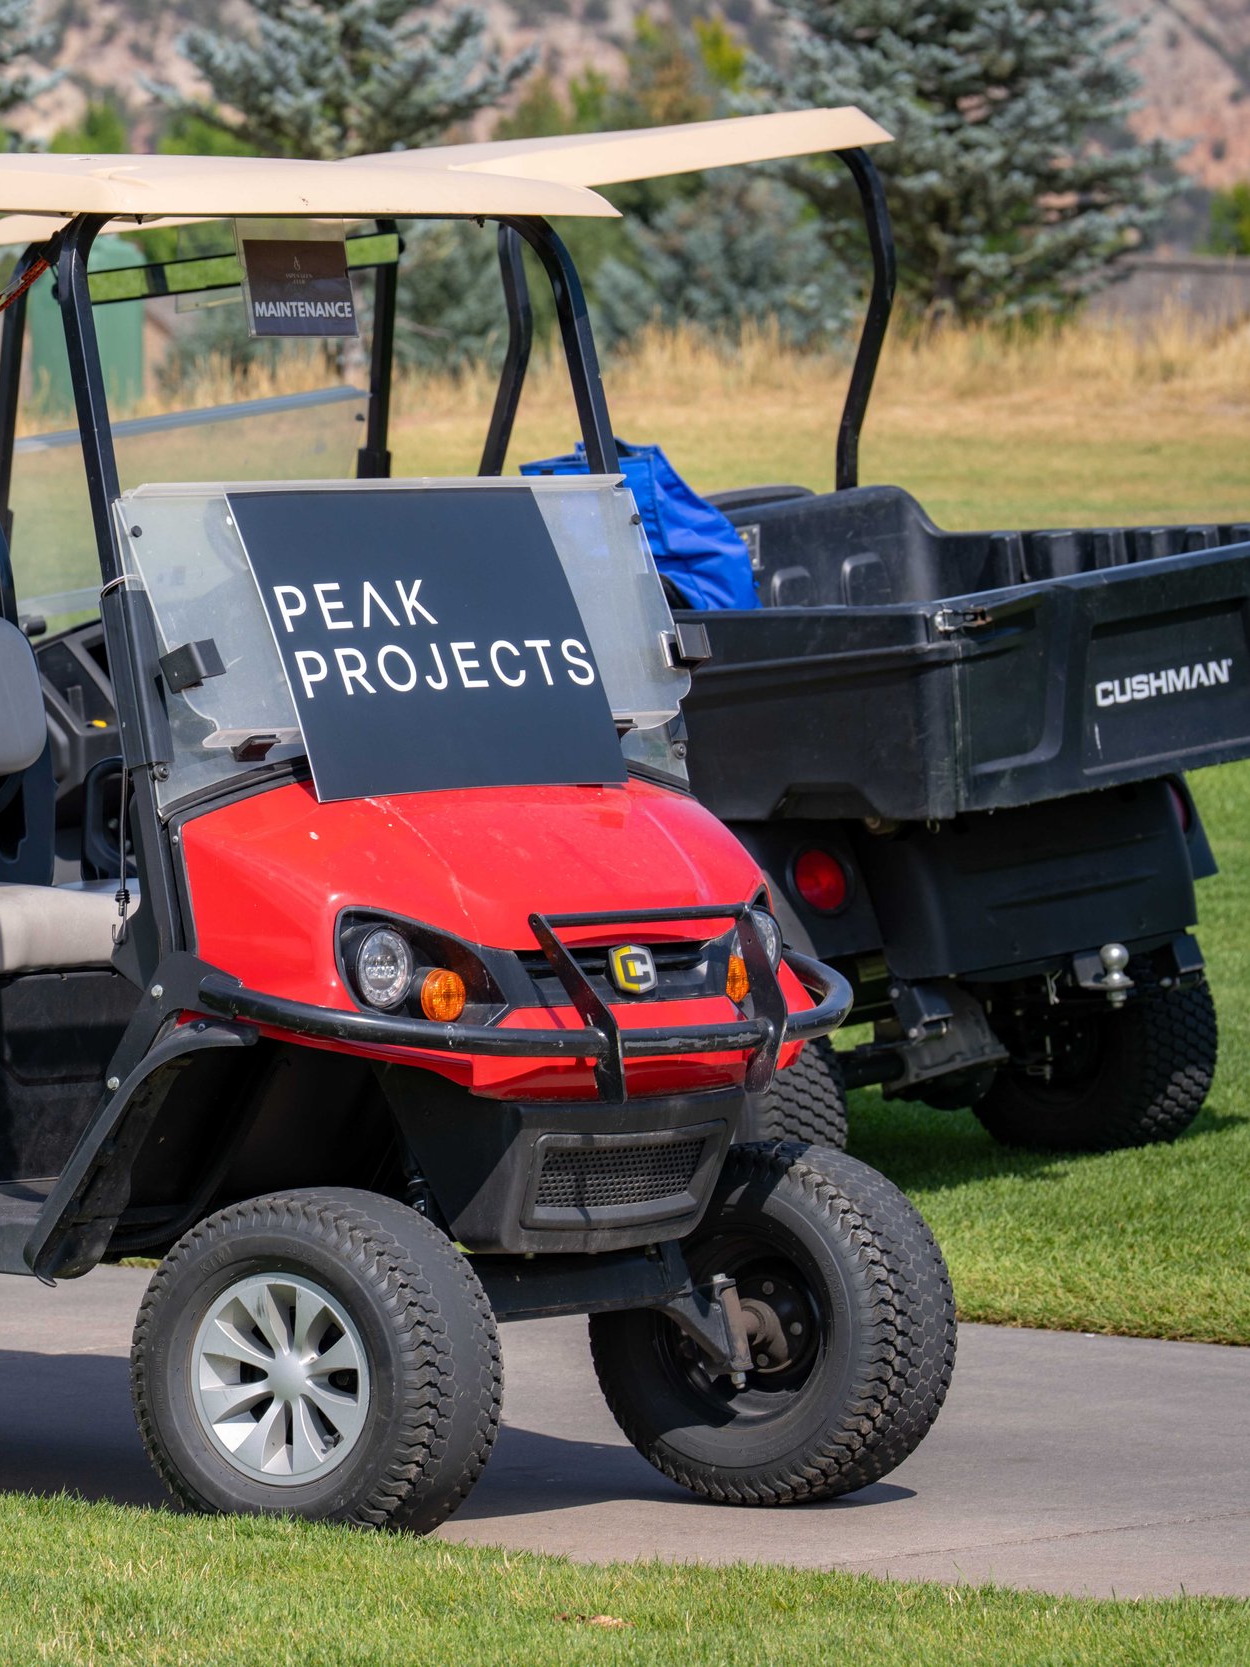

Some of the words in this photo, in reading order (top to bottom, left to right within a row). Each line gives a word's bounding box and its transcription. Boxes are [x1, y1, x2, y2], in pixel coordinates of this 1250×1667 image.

[254, 301, 353, 318] MAINTENANCE
[272, 579, 439, 633] PEAK
[294, 638, 596, 699] PROJECTS
